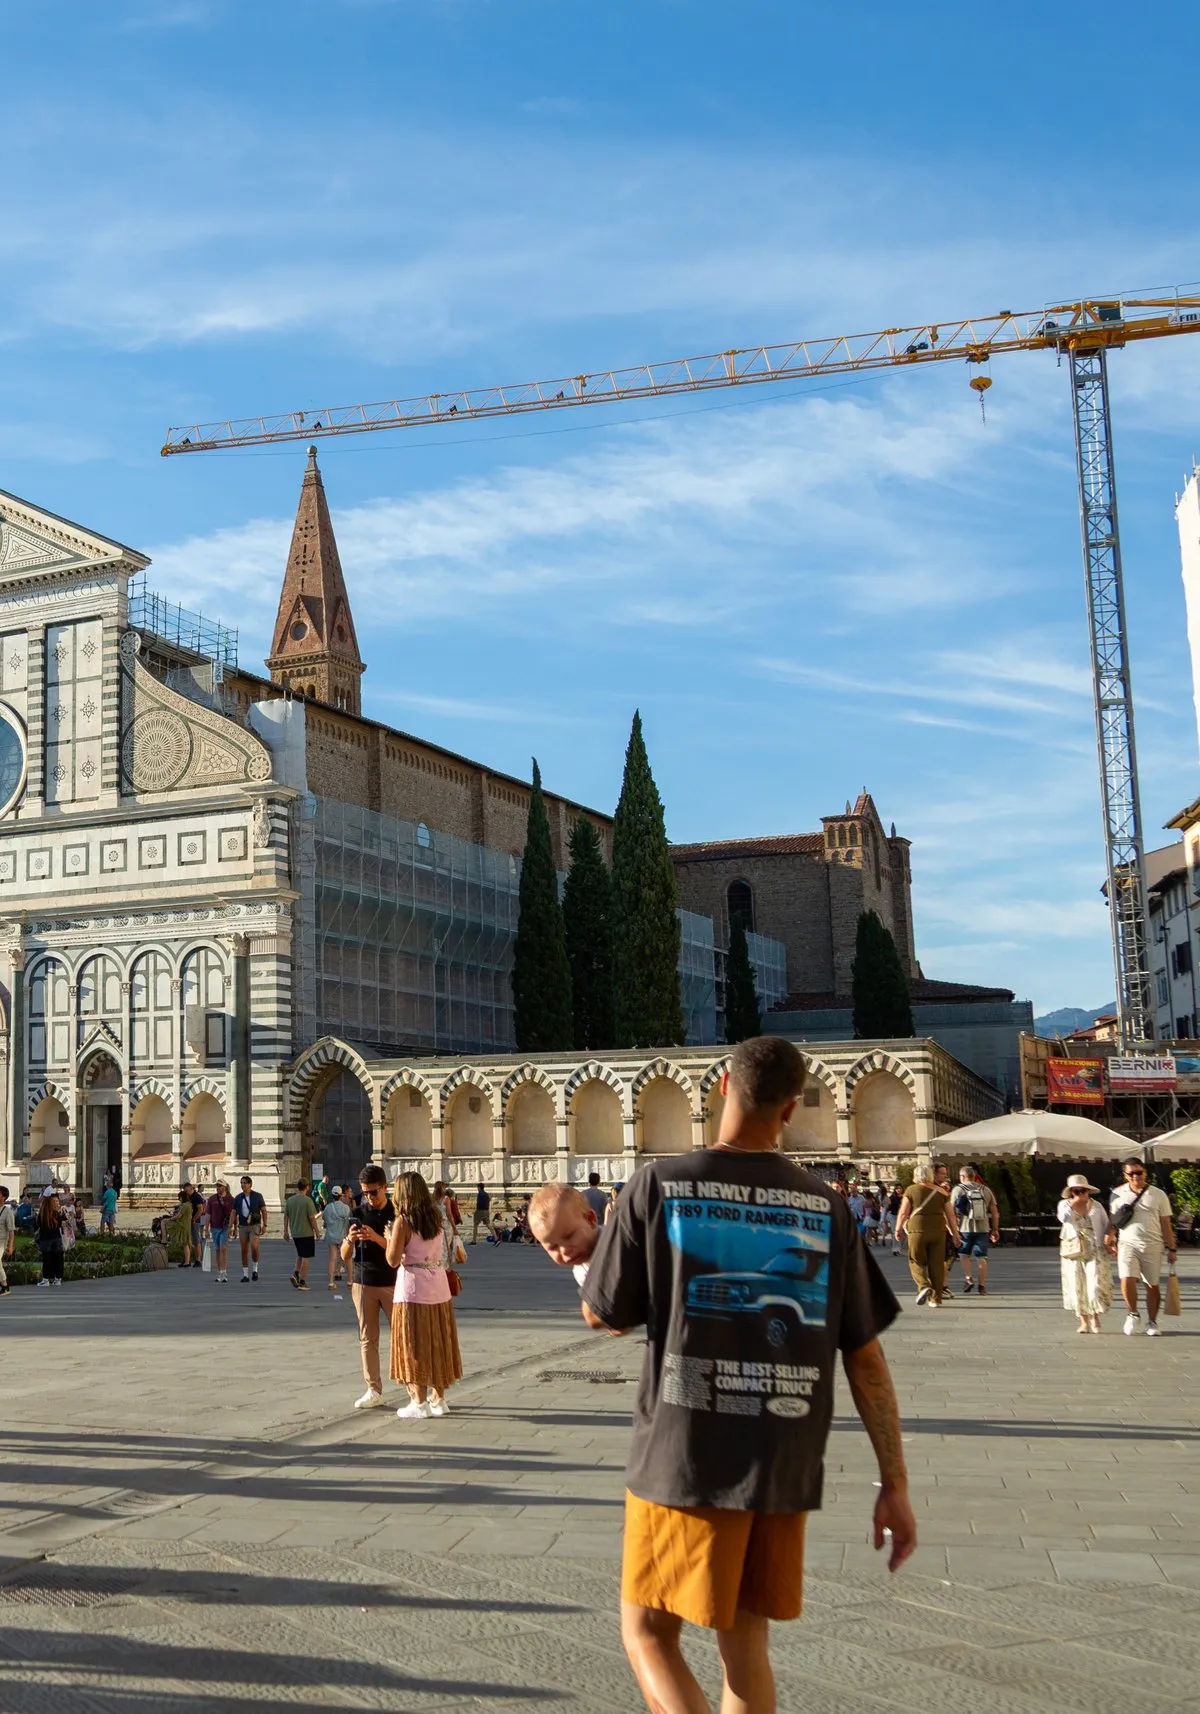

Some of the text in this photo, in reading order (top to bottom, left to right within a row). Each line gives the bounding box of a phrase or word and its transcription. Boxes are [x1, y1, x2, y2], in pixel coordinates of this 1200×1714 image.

[662, 1181, 831, 1212] THE NEWLY DESIGNED
[669, 1204, 704, 1219] 1989
[707, 1205, 741, 1222] FORD
[745, 1210, 799, 1228] RANGER
[715, 1359, 820, 1381] THE BEST-SELLING
[715, 1376, 813, 1396] COMPACT TRUCK
